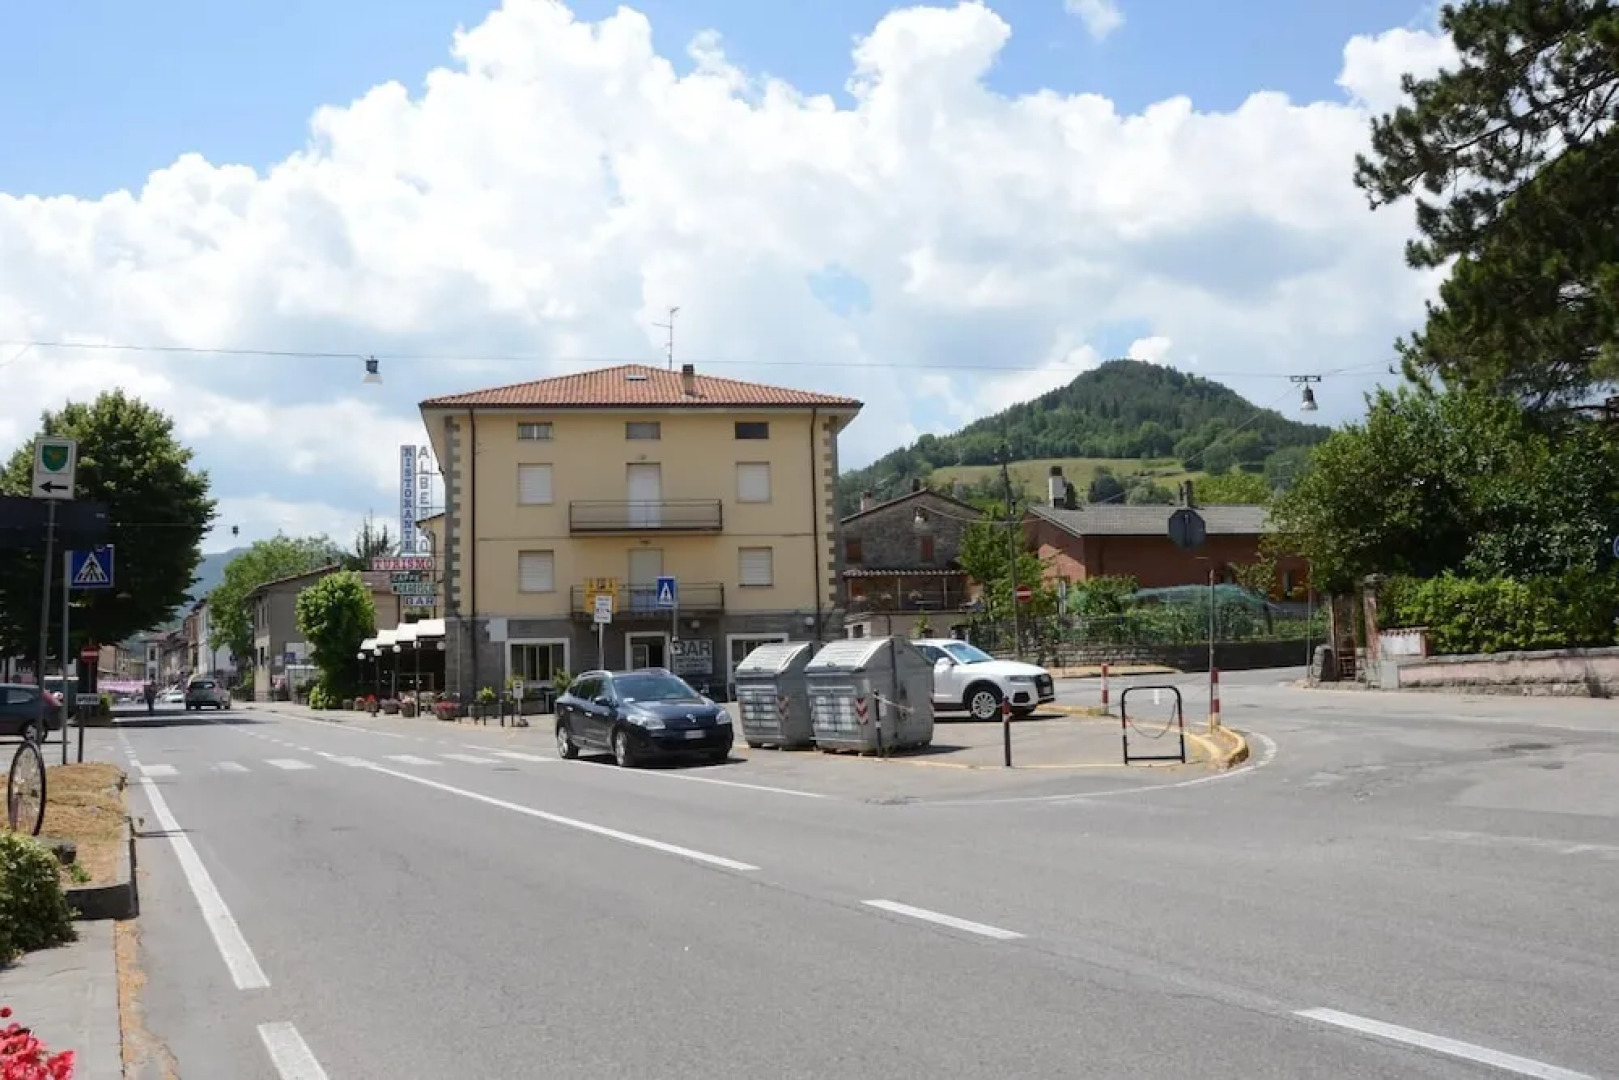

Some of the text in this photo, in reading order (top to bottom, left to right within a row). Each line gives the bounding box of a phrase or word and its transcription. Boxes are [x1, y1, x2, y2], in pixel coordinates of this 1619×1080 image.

[403, 447, 413, 551] RISTORANTE
[375, 558, 433, 569] TURISMO
[405, 597, 433, 605] BAR
